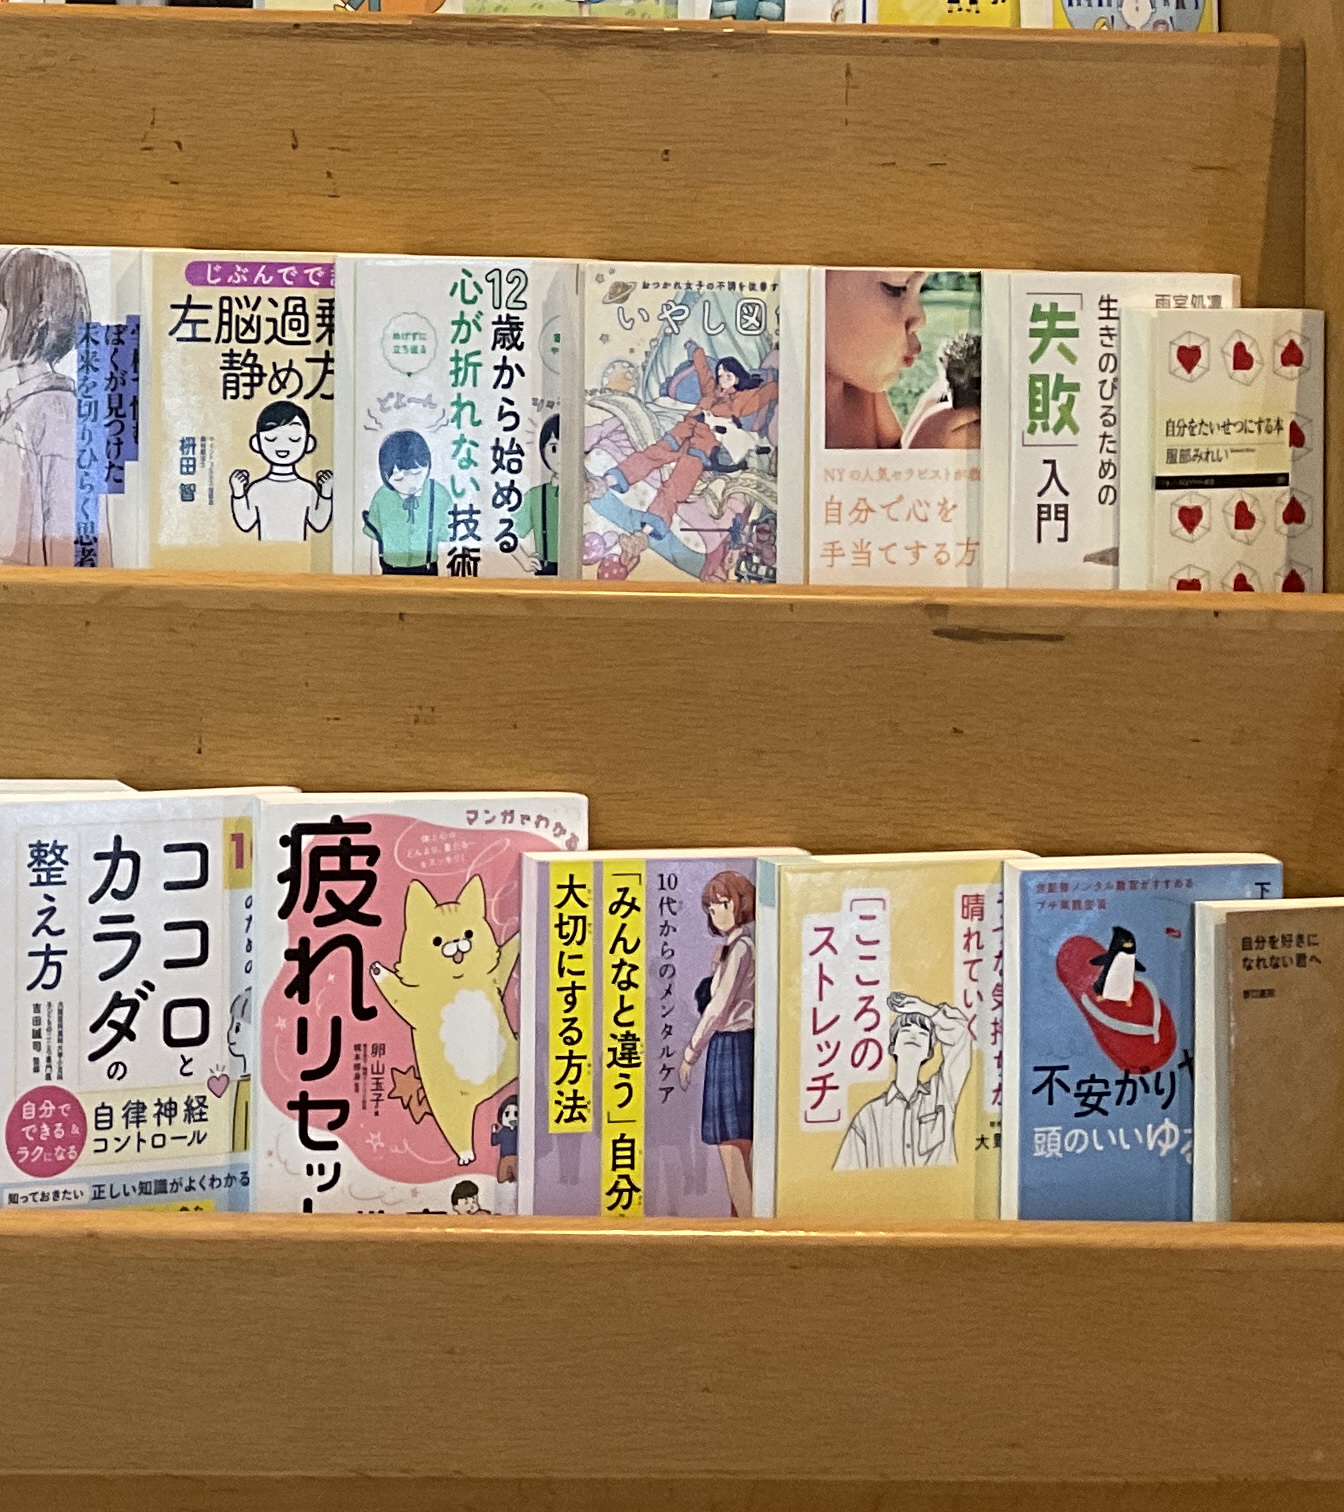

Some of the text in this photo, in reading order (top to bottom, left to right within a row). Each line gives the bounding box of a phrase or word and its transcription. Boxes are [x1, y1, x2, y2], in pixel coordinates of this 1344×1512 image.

[104, 323, 127, 484] ぼくが見つけた
[220, 349, 335, 401] 静め方
[447, 268, 484, 577] 心が折れない技術
[485, 268, 529, 555] 12歳から始める
[1022, 292, 1084, 544] 「失敗」入門
[1098, 294, 1120, 506] 生きのびるための
[1165, 417, 1285, 438] 自分をたいせつにする本
[820, 540, 980, 569] 手当てする方
[824, 496, 959, 526] 自分で心を
[26, 839, 70, 991] 整え方
[87, 834, 156, 1081] カラダの
[162, 841, 211, 1077] ココロと
[1241, 953, 1322, 972] なれない君へ
[1242, 933, 1320, 951] 自分を好きに
[553, 873, 589, 1125] 大切にする方法
[657, 872, 679, 1105] 10代からのメンタルケア
[960, 893, 985, 1042] 晴れていく
[605, 872, 643, 1211] 「みんなと違う」自分
[16, 1144, 79, 1164] ラクになる
[20, 1122, 65, 1140] できる
[21, 1101, 71, 1120] 自分で
[92, 1128, 208, 1155] コントロール
[93, 1094, 210, 1131] 自律神経
[7, 1170, 251, 1206] 知っておきたい 正しい知識がよくわかる
